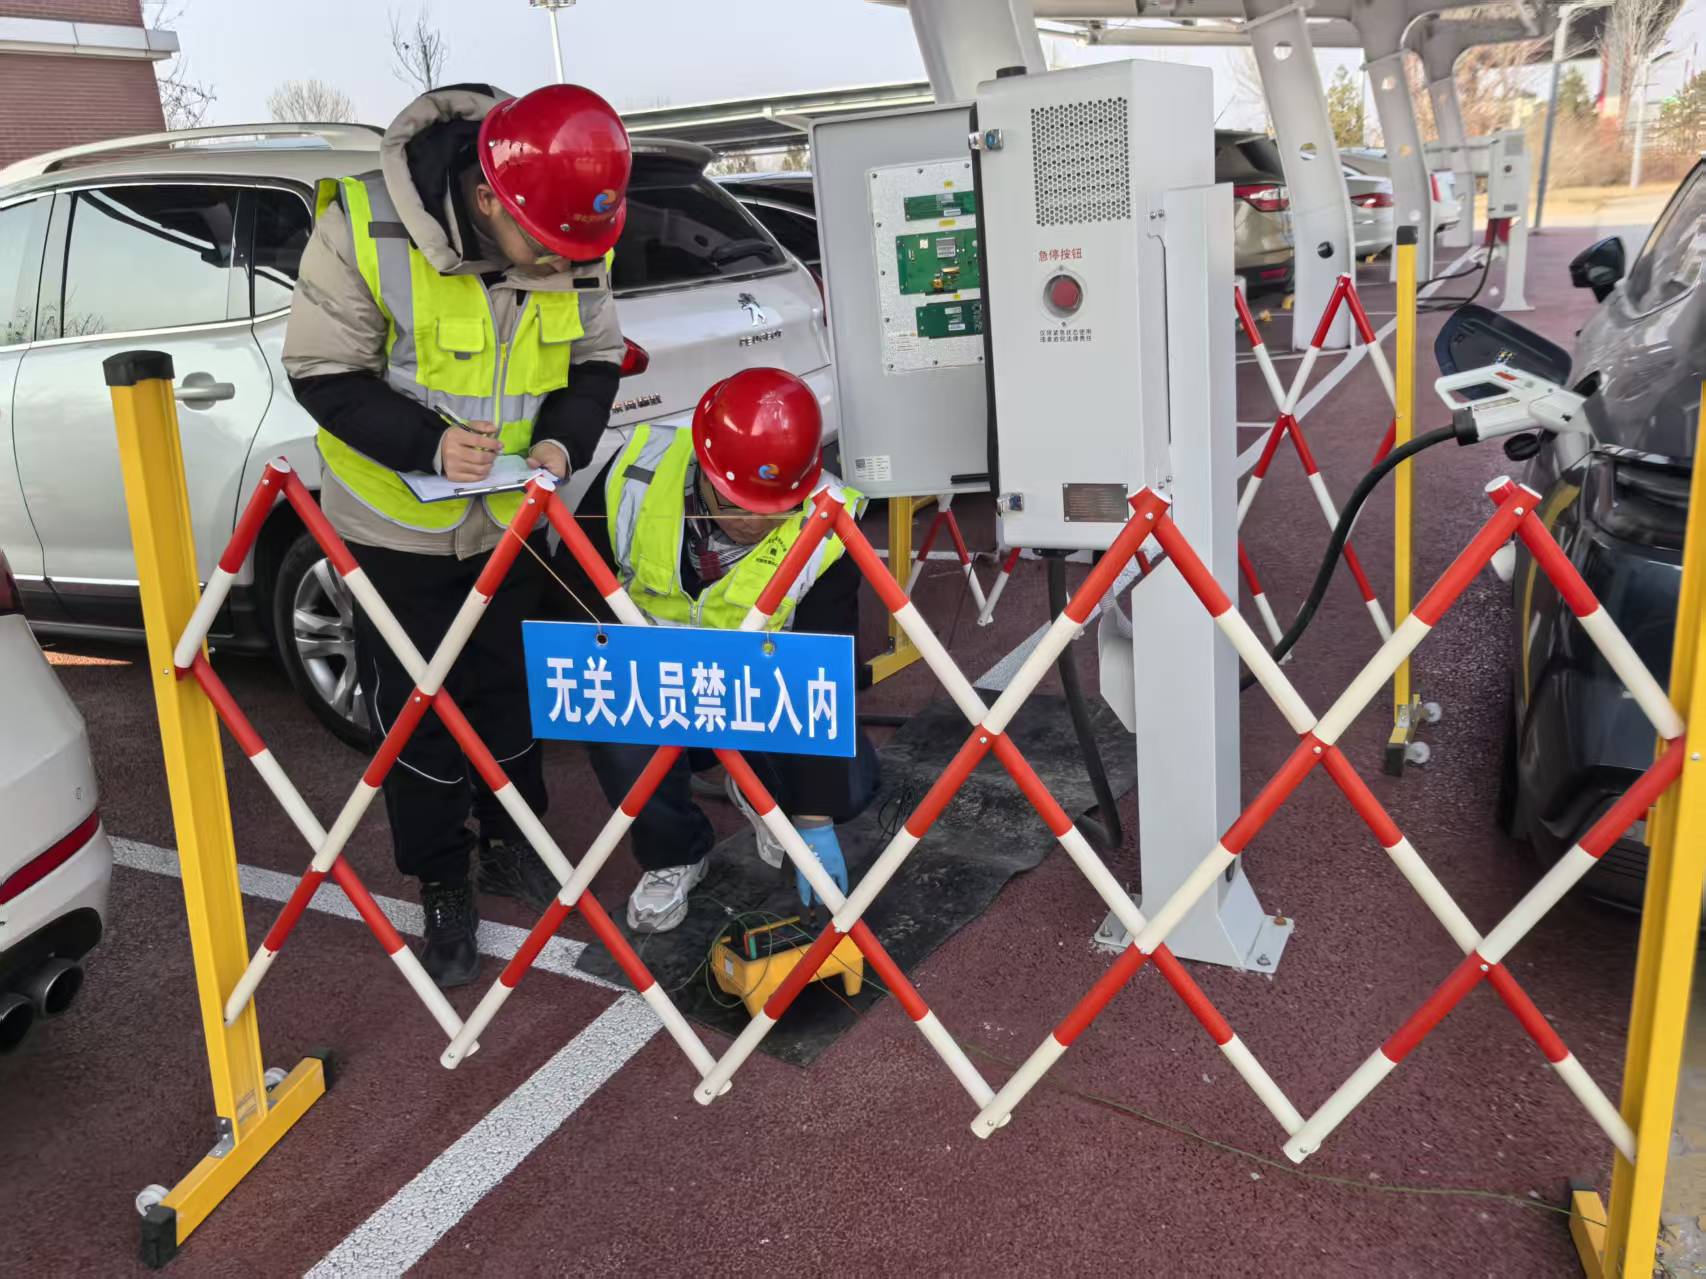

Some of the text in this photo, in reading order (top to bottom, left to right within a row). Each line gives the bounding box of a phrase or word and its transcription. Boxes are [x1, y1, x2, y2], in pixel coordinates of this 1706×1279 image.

[1039, 248, 1082, 262] 急停按钮
[546, 656, 839, 740] 无关人员禁止入内
